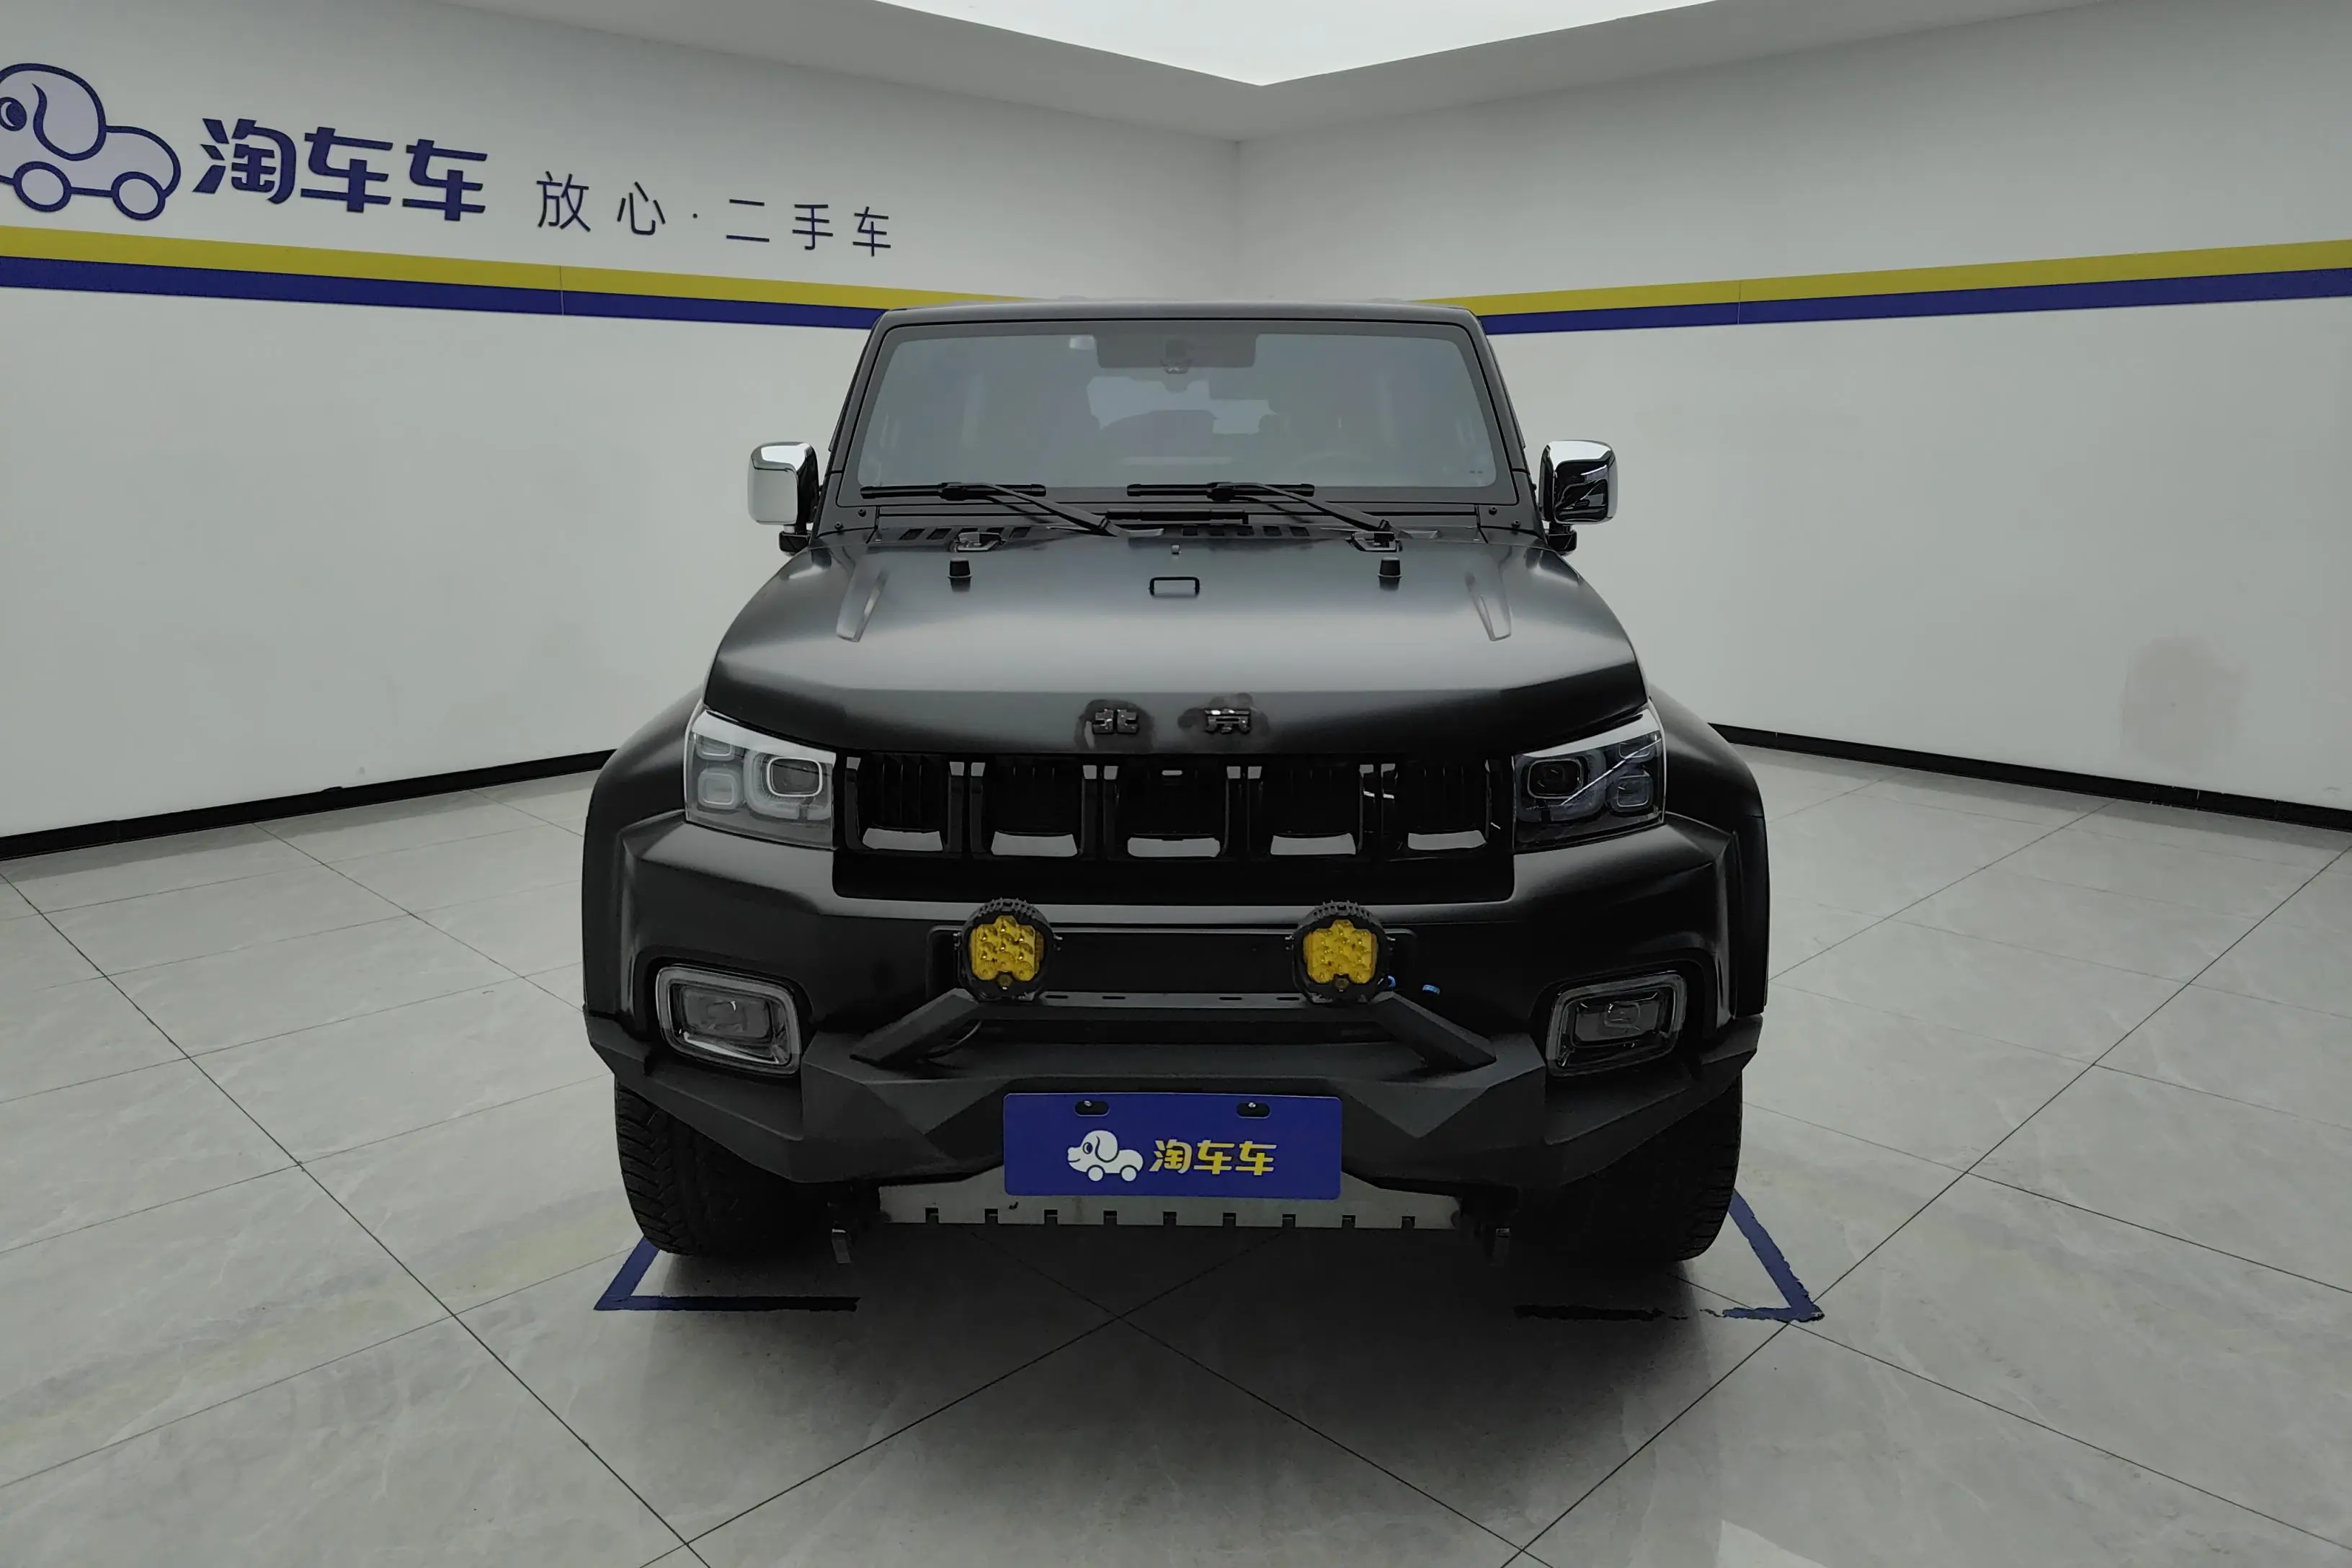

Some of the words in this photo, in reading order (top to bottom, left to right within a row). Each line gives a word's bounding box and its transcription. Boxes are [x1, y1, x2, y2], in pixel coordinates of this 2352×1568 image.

[193, 117, 487, 221] 淘车车
[537, 171, 891, 257] 放心·二手车
[1149, 1139, 1277, 1175] 淘车车
